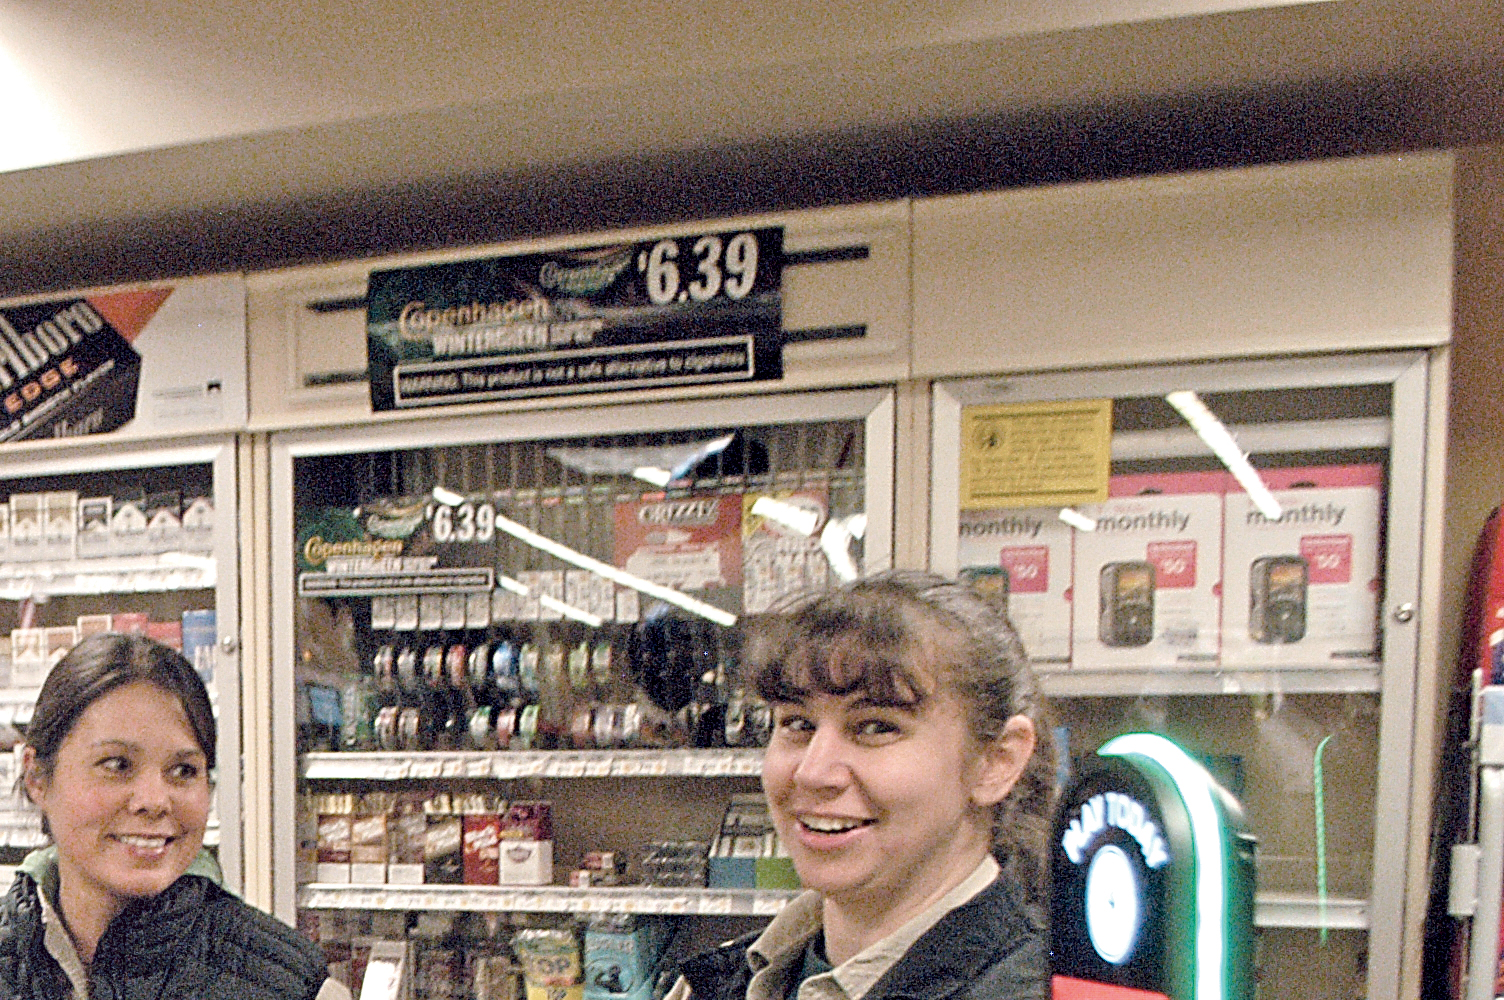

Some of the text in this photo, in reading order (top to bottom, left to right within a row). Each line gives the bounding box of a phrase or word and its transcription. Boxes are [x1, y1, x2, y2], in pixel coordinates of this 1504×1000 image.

[399, 299, 549, 341] Copenhagen
[1096, 509, 1190, 533] monthly
[305, 536, 403, 566] Copenhagen
[1061, 791, 1169, 869] PLAY TODAY
